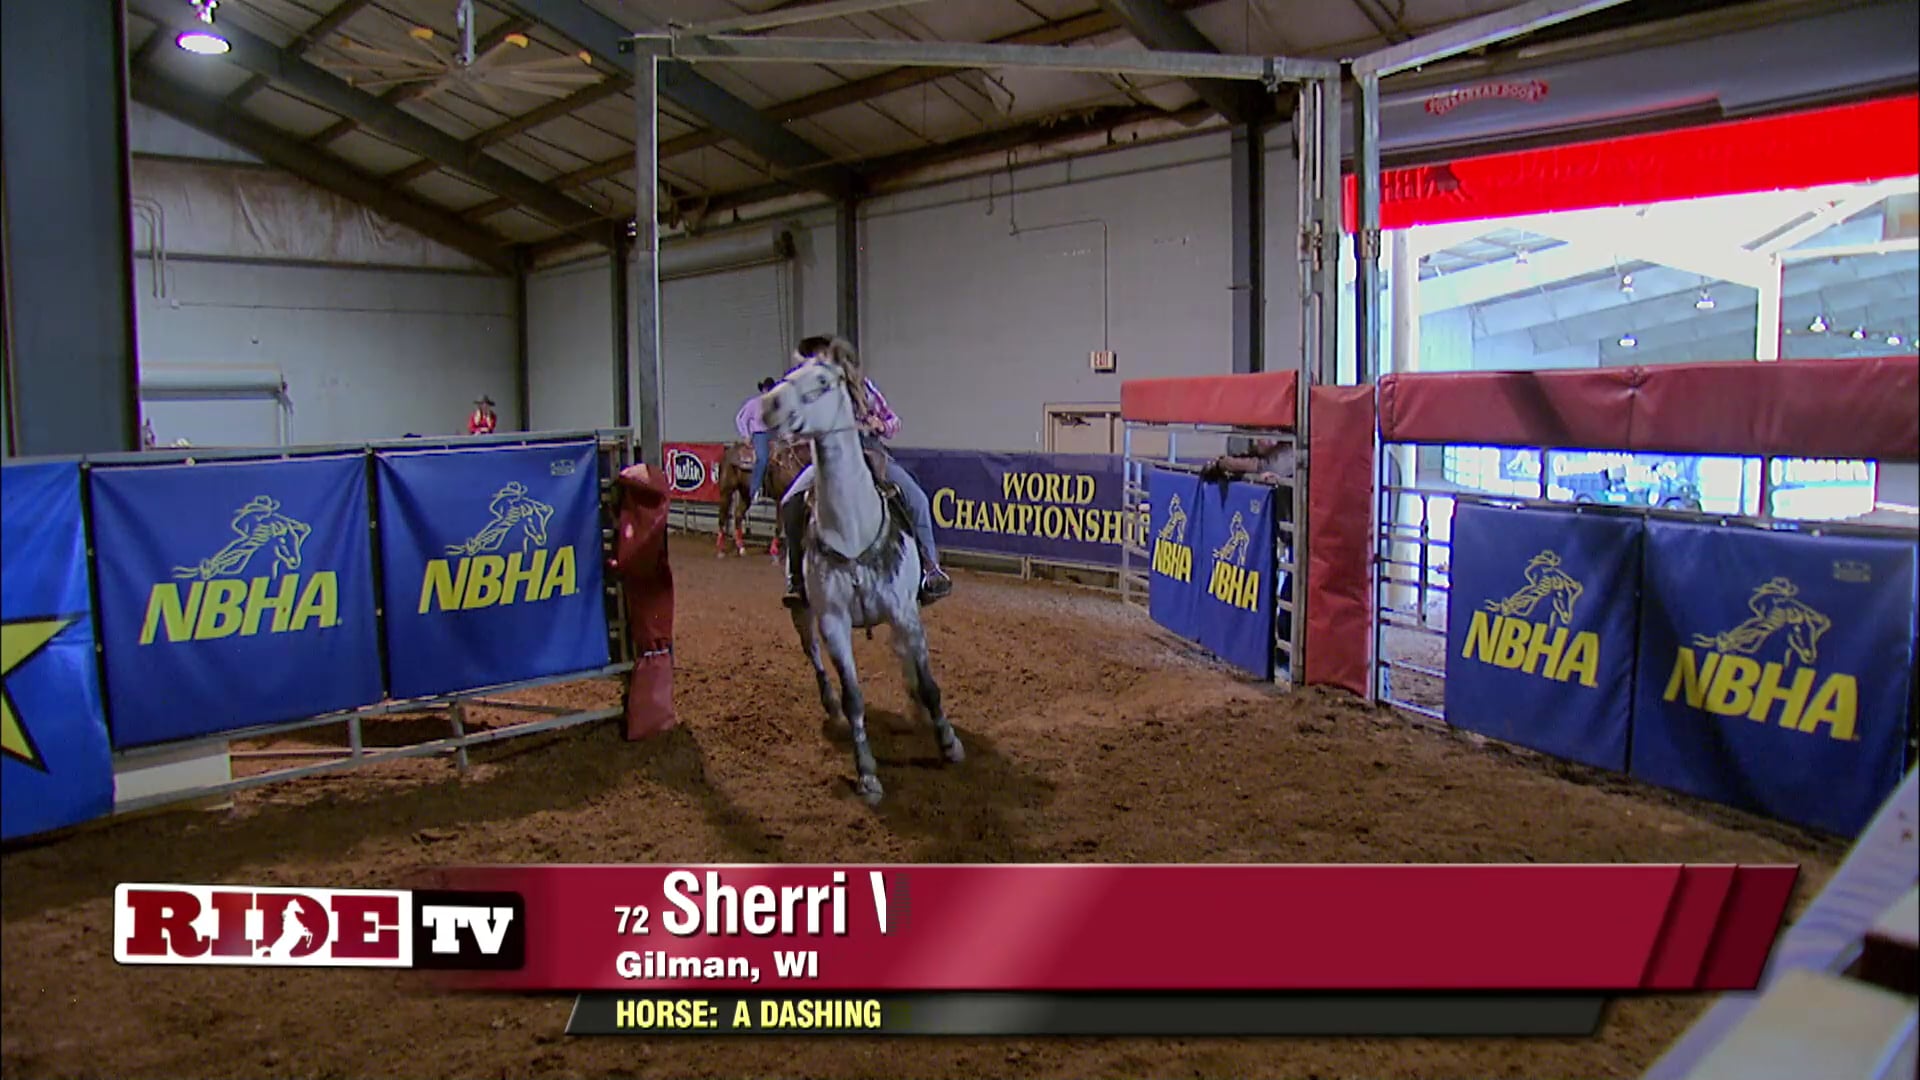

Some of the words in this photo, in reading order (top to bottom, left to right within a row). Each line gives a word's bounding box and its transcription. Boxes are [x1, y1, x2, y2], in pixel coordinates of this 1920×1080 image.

[1002, 472, 1095, 504] WORLD
[419, 546, 578, 613] NBHA
[1152, 537, 1192, 583] NBHA
[1208, 559, 1259, 613] NBHA
[139, 571, 339, 645] NBHA
[1461, 610, 1599, 688] NBHA
[1664, 646, 1859, 740] NBHA
